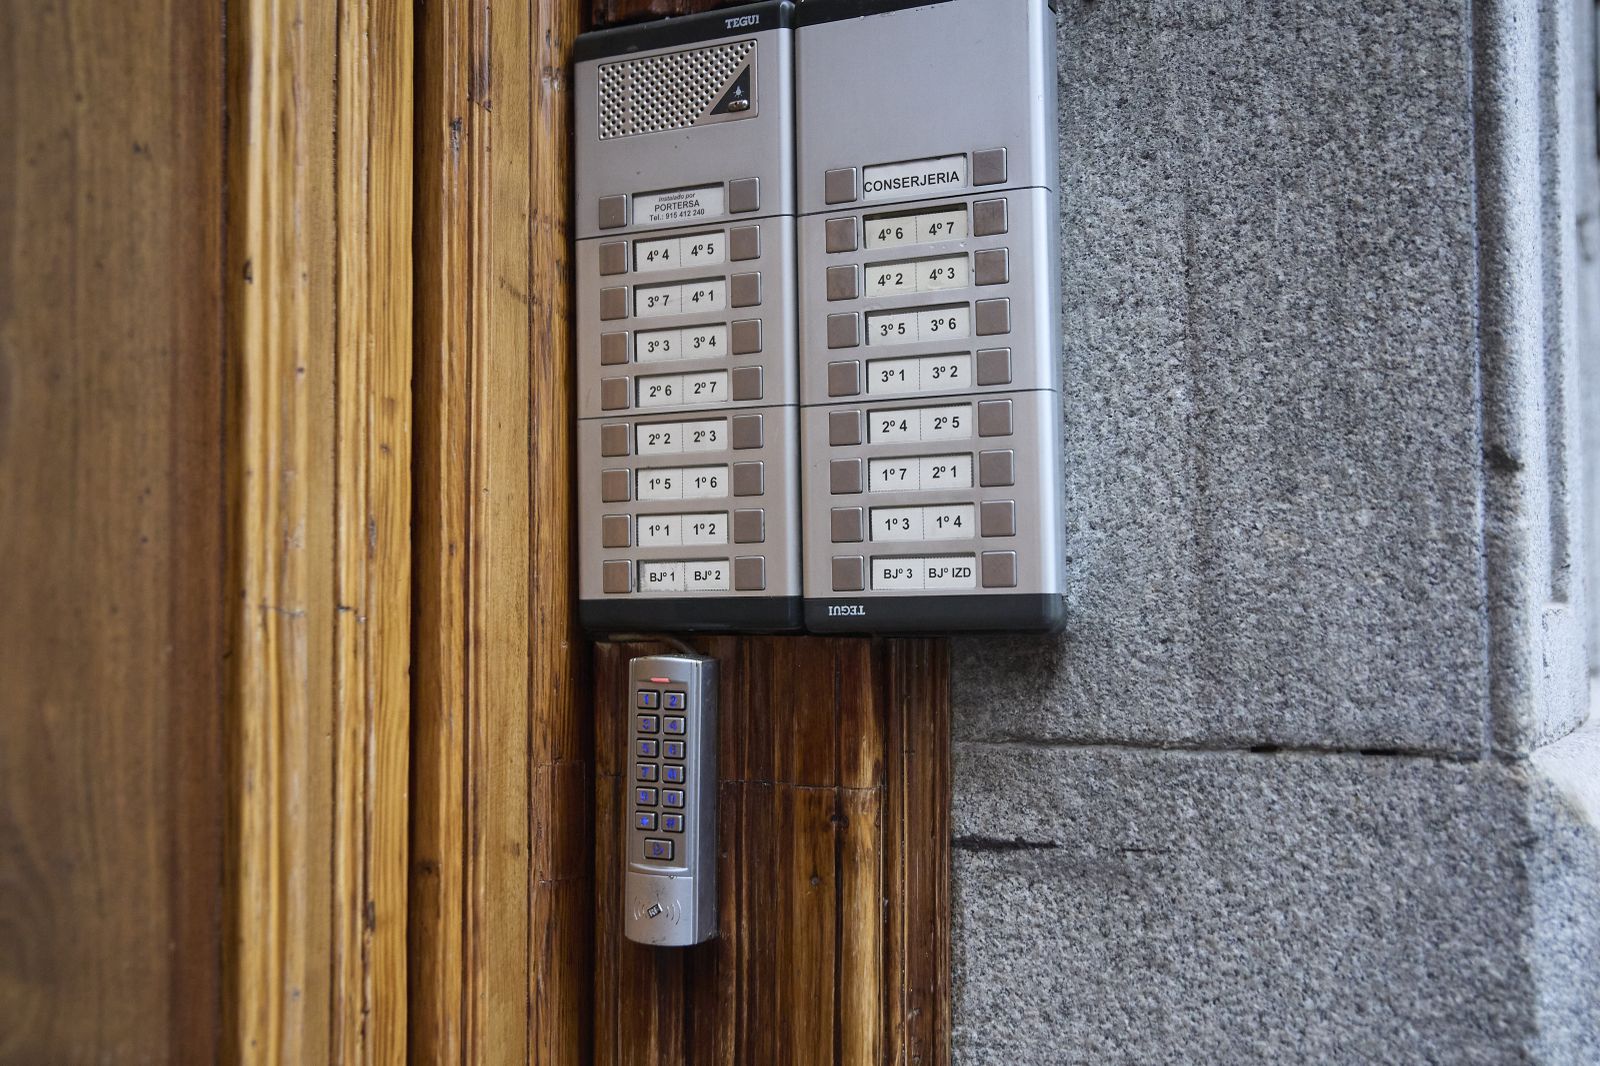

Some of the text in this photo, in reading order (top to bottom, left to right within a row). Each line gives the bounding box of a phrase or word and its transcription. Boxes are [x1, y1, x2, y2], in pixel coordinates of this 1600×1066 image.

[725, 15, 760, 29] TEGUI
[864, 171, 960, 193] CONSERJERIA
[658, 192, 695, 202] instalado por
[654, 200, 700, 212] PORTERSA
[679, 210, 691, 219] 412
[693, 208, 705, 217] 240
[895, 227, 904, 240] 6
[946, 221, 955, 235] 7
[661, 248, 670, 261] 4
[707, 242, 715, 255] 5
[895, 272, 904, 286] 2
[947, 267, 955, 280] 3
[662, 294, 670, 307] 7
[708, 289, 714, 302] 1
[897, 322, 906, 335] 5
[948, 317, 957, 330] 6
[663, 339, 670, 352] 3
[708, 335, 717, 348] 4
[898, 369, 905, 382] 1
[949, 365, 958, 378] 2
[664, 384, 672, 397] 6
[709, 381, 717, 393] 7
[899, 419, 908, 432] 4
[952, 415, 960, 429] 5
[663, 432, 671, 445] 2
[709, 430, 717, 442] 3
[899, 467, 907, 481] 7
[950, 465, 957, 478] 1
[664, 478, 672, 490] 5
[709, 476, 718, 489] 6
[902, 517, 910, 531] 3
[953, 515, 963, 528] 4
[664, 524, 670, 537] 1
[708, 522, 716, 536] 2
[669, 571, 675, 582] 1
[714, 569, 721, 581] 2
[906, 568, 913, 579] 3
[951, 567, 972, 578] IZD
[828, 605, 865, 616] TEGUI
[643, 694, 650, 705] 1
[670, 696, 677, 706] 2
[669, 719, 678, 732] 4
